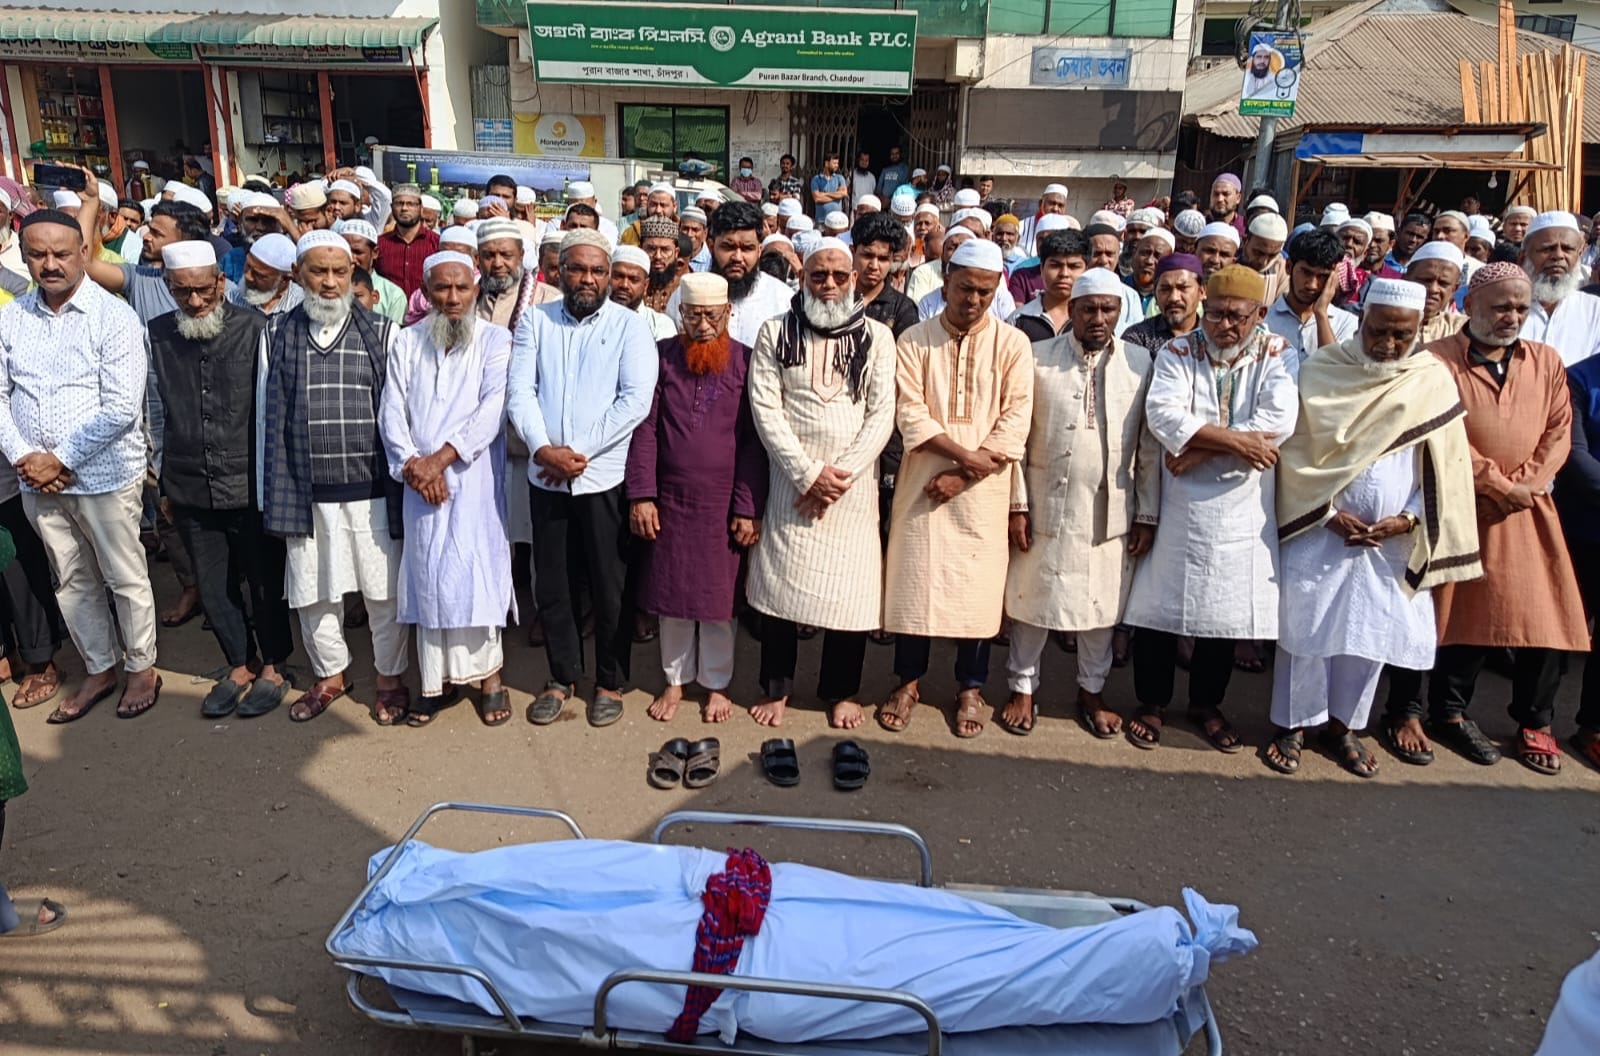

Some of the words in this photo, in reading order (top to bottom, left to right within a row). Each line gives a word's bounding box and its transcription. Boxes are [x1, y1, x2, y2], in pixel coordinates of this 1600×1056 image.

[533, 23, 586, 39] অগ্রণী
[589, 26, 635, 42] ব্যাংক
[740, 29, 806, 48] Agrani
[811, 30, 863, 46] Bank
[868, 31, 912, 48] PLC.
[582, 66, 603, 76] পুরান
[606, 67, 630, 76] বাজার
[632, 68, 655, 79] শাখা,
[1097, 57, 1127, 80] ভবন
[758, 72, 780, 81] Puran
[781, 72, 801, 82] Bazar
[802, 74, 829, 82] Branch,
[830, 73, 865, 84] Chandpur
[539, 138, 580, 148] MoneyGram
